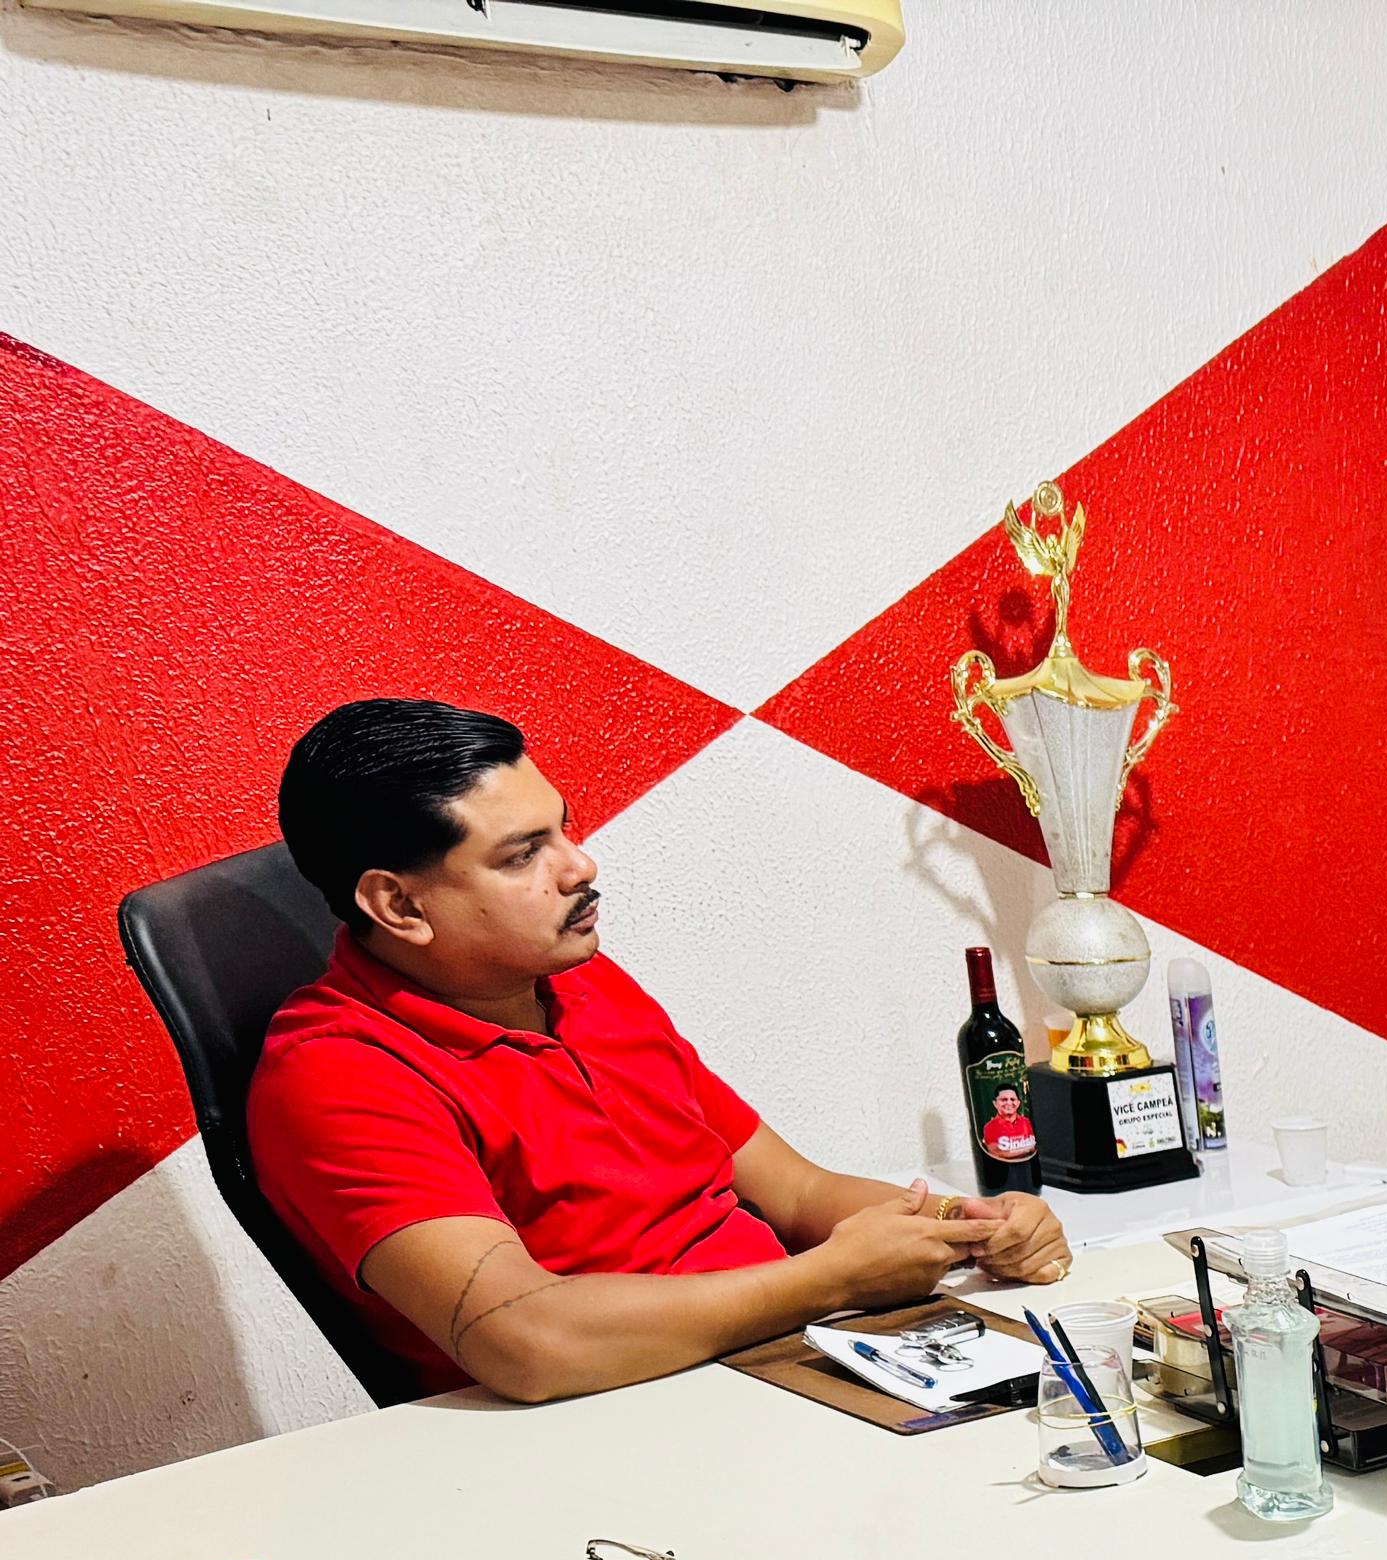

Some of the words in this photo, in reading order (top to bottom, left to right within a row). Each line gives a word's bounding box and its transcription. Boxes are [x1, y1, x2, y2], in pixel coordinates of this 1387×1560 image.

[1113, 1102, 1135, 1116] VICE
[1118, 1116, 1142, 1126] GRUPO
[1142, 1111, 1173, 1122] ESPECIAL
